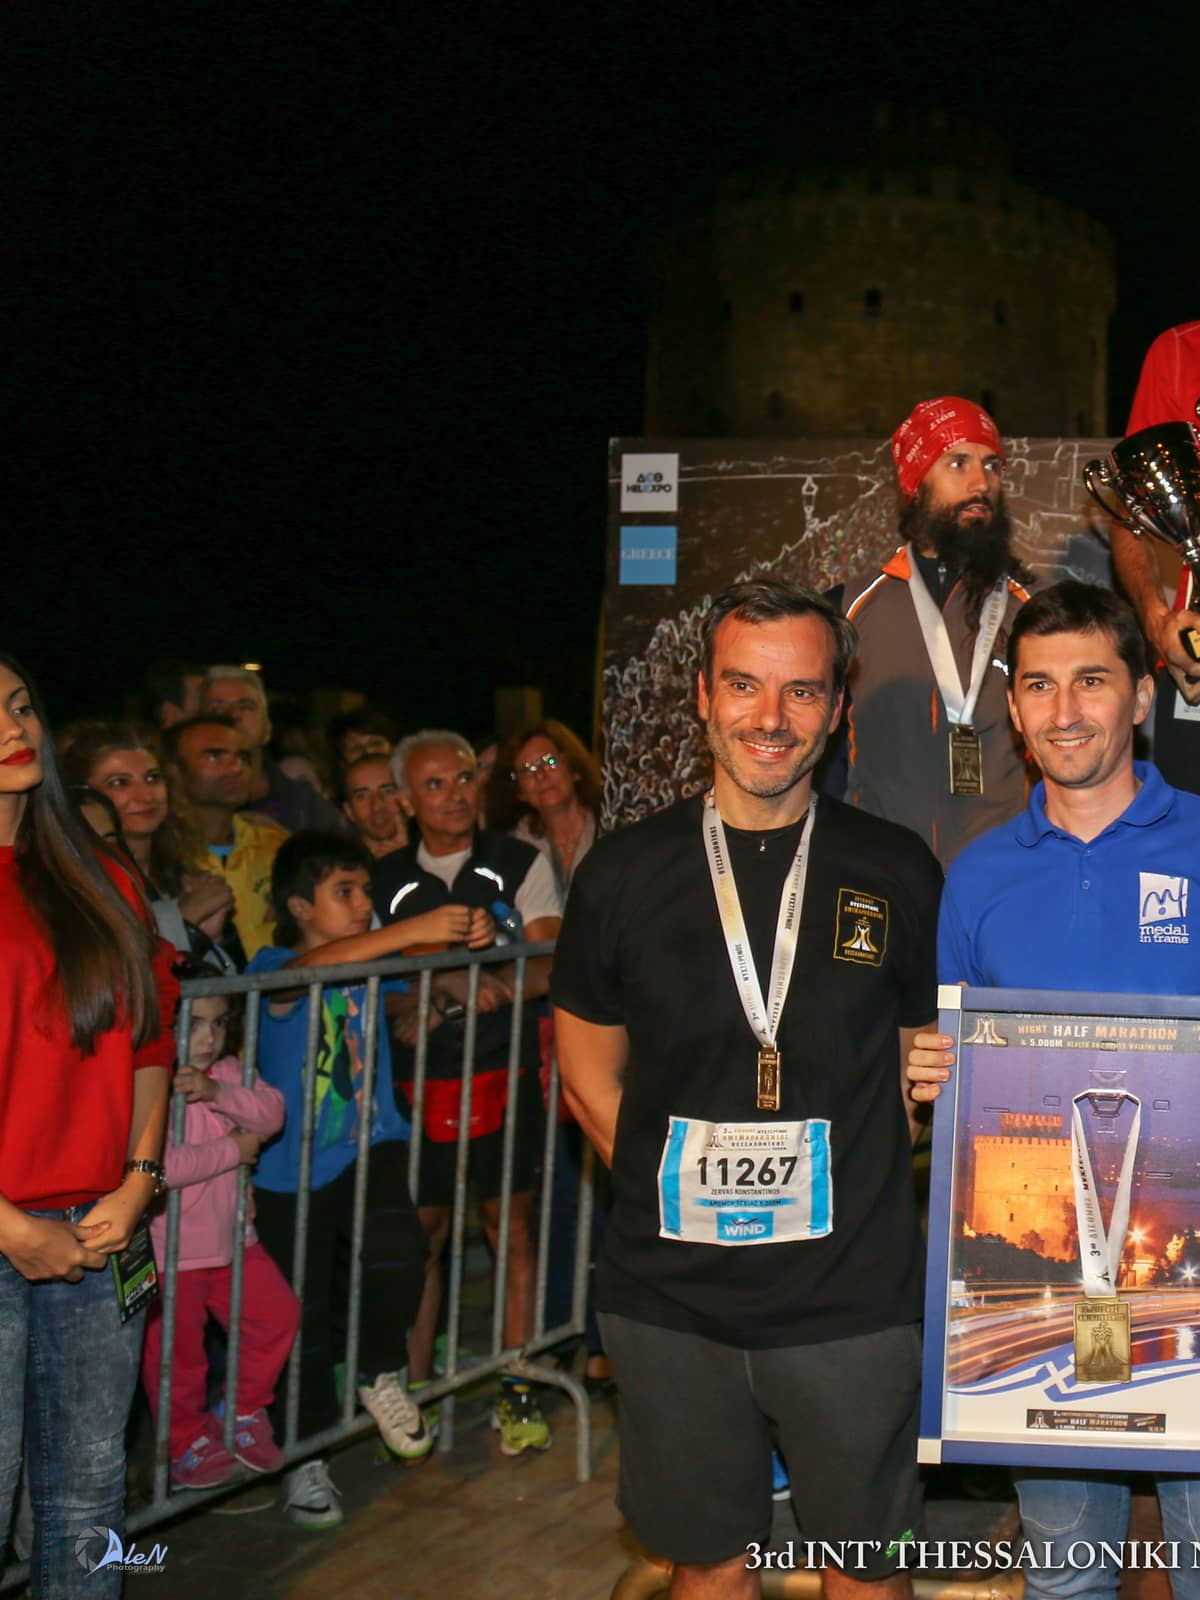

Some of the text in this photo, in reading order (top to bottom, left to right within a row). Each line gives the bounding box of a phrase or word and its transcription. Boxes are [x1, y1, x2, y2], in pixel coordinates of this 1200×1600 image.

[626, 484, 673, 493] HELEXPO
[1139, 924, 1189, 936] medal
[1154, 935, 1189, 944] frame
[1053, 1025, 1089, 1038] HALF
[1095, 1026, 1178, 1041] MARATHON
[1029, 1037, 1064, 1048] 5.000M
[697, 1156, 798, 1186] 11267
[710, 1188, 781, 1196] ZERVAS KONSTANTINOS
[724, 1224, 767, 1237] WIND
